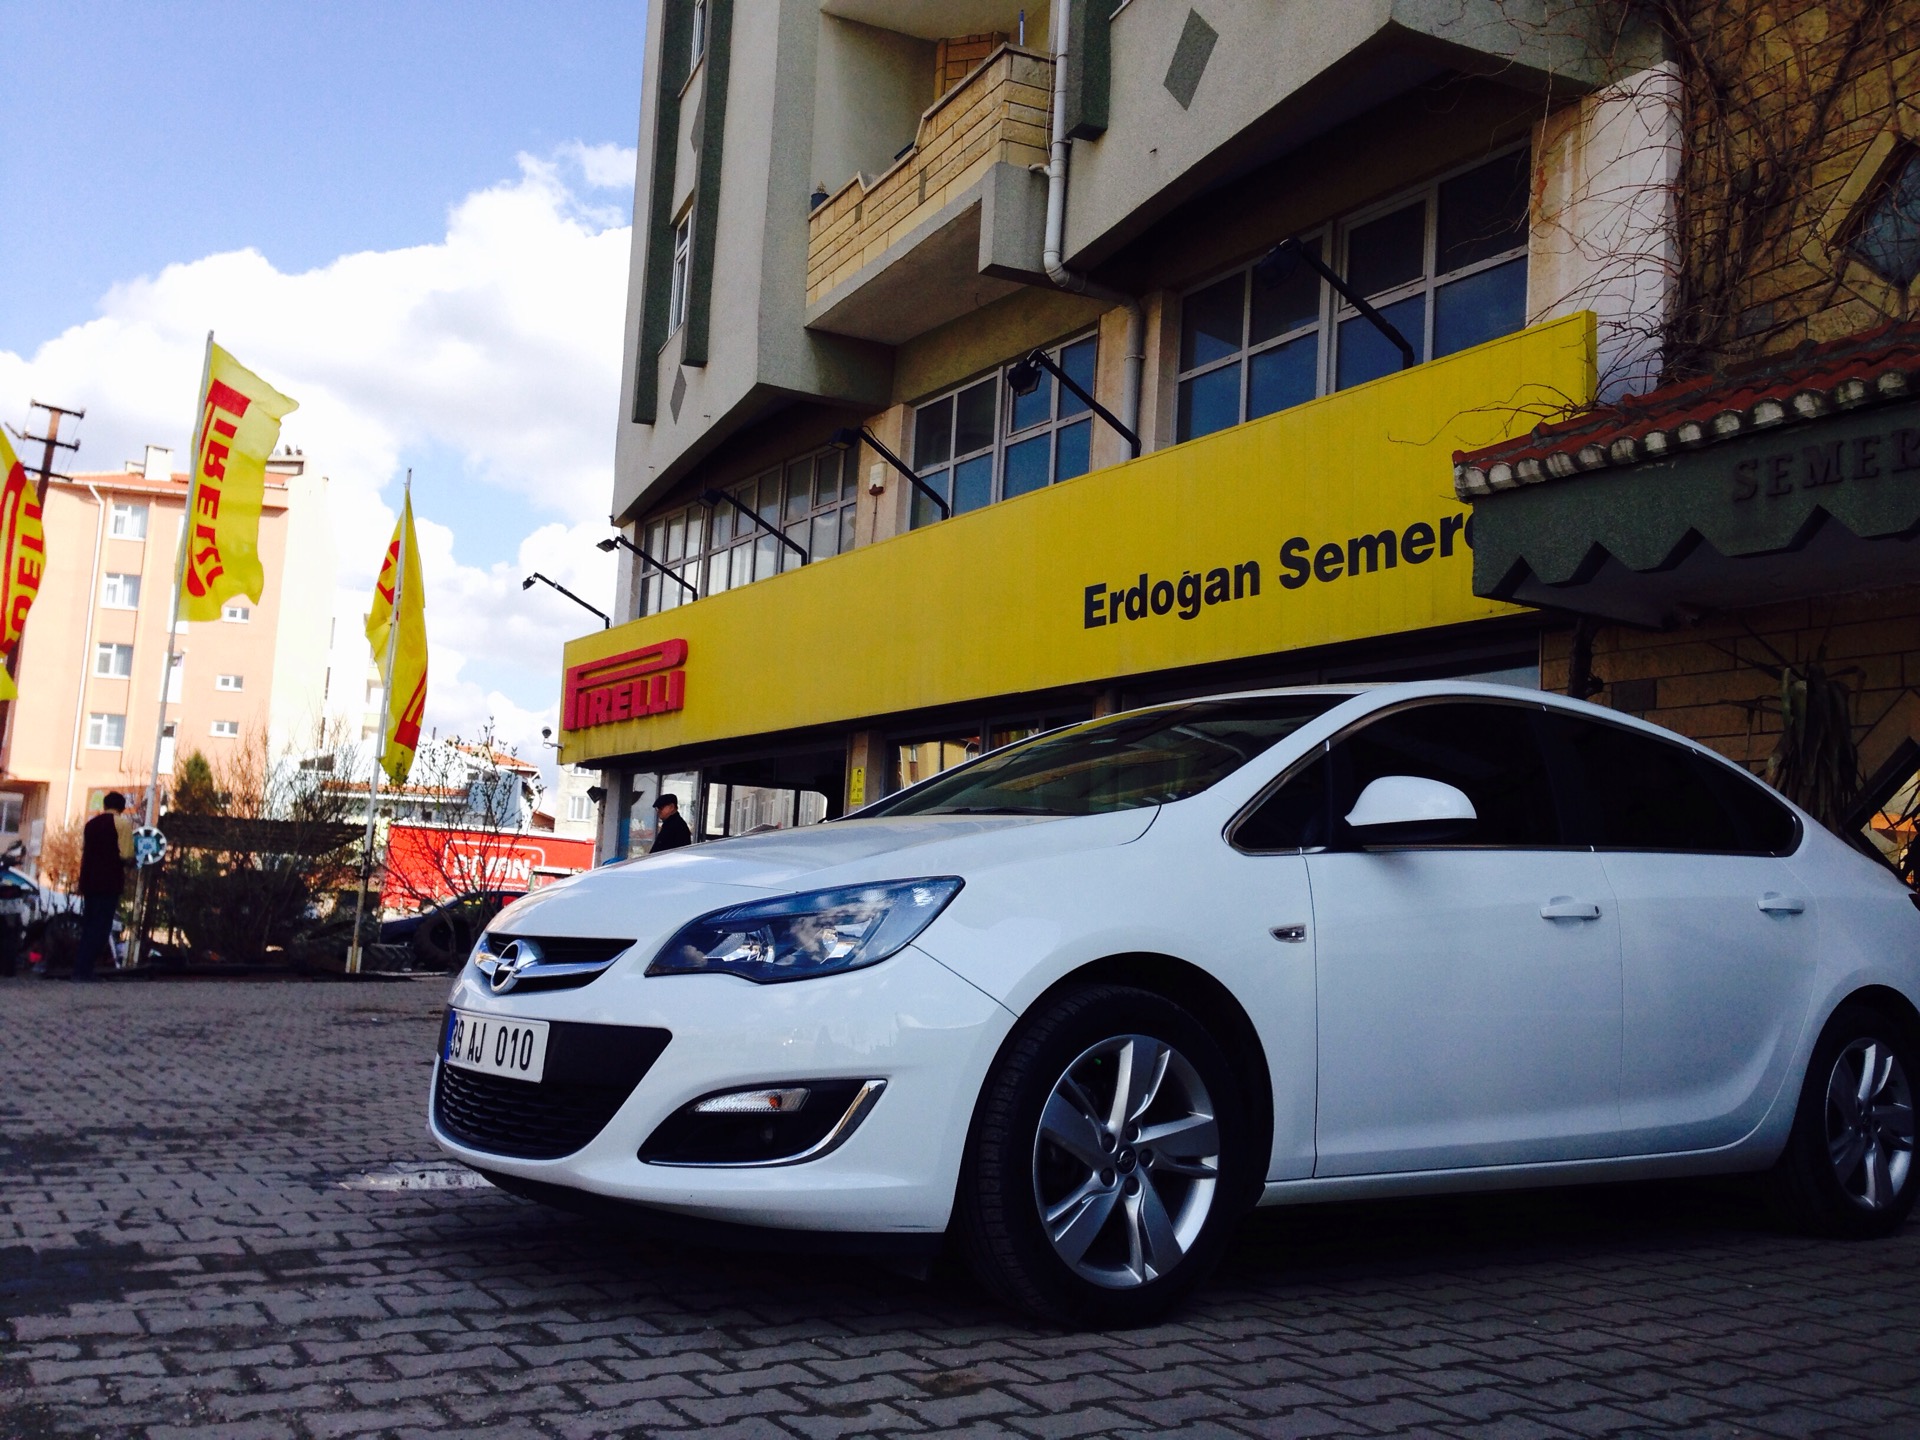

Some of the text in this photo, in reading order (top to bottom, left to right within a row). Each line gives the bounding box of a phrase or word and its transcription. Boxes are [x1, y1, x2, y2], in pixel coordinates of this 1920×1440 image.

[1731, 428, 1920, 504] SEMER
[1084, 560, 1260, 630] Erdoğan
[563, 638, 688, 731] PIRELLI
[450, 1019, 534, 1071] 39 AJ 010
